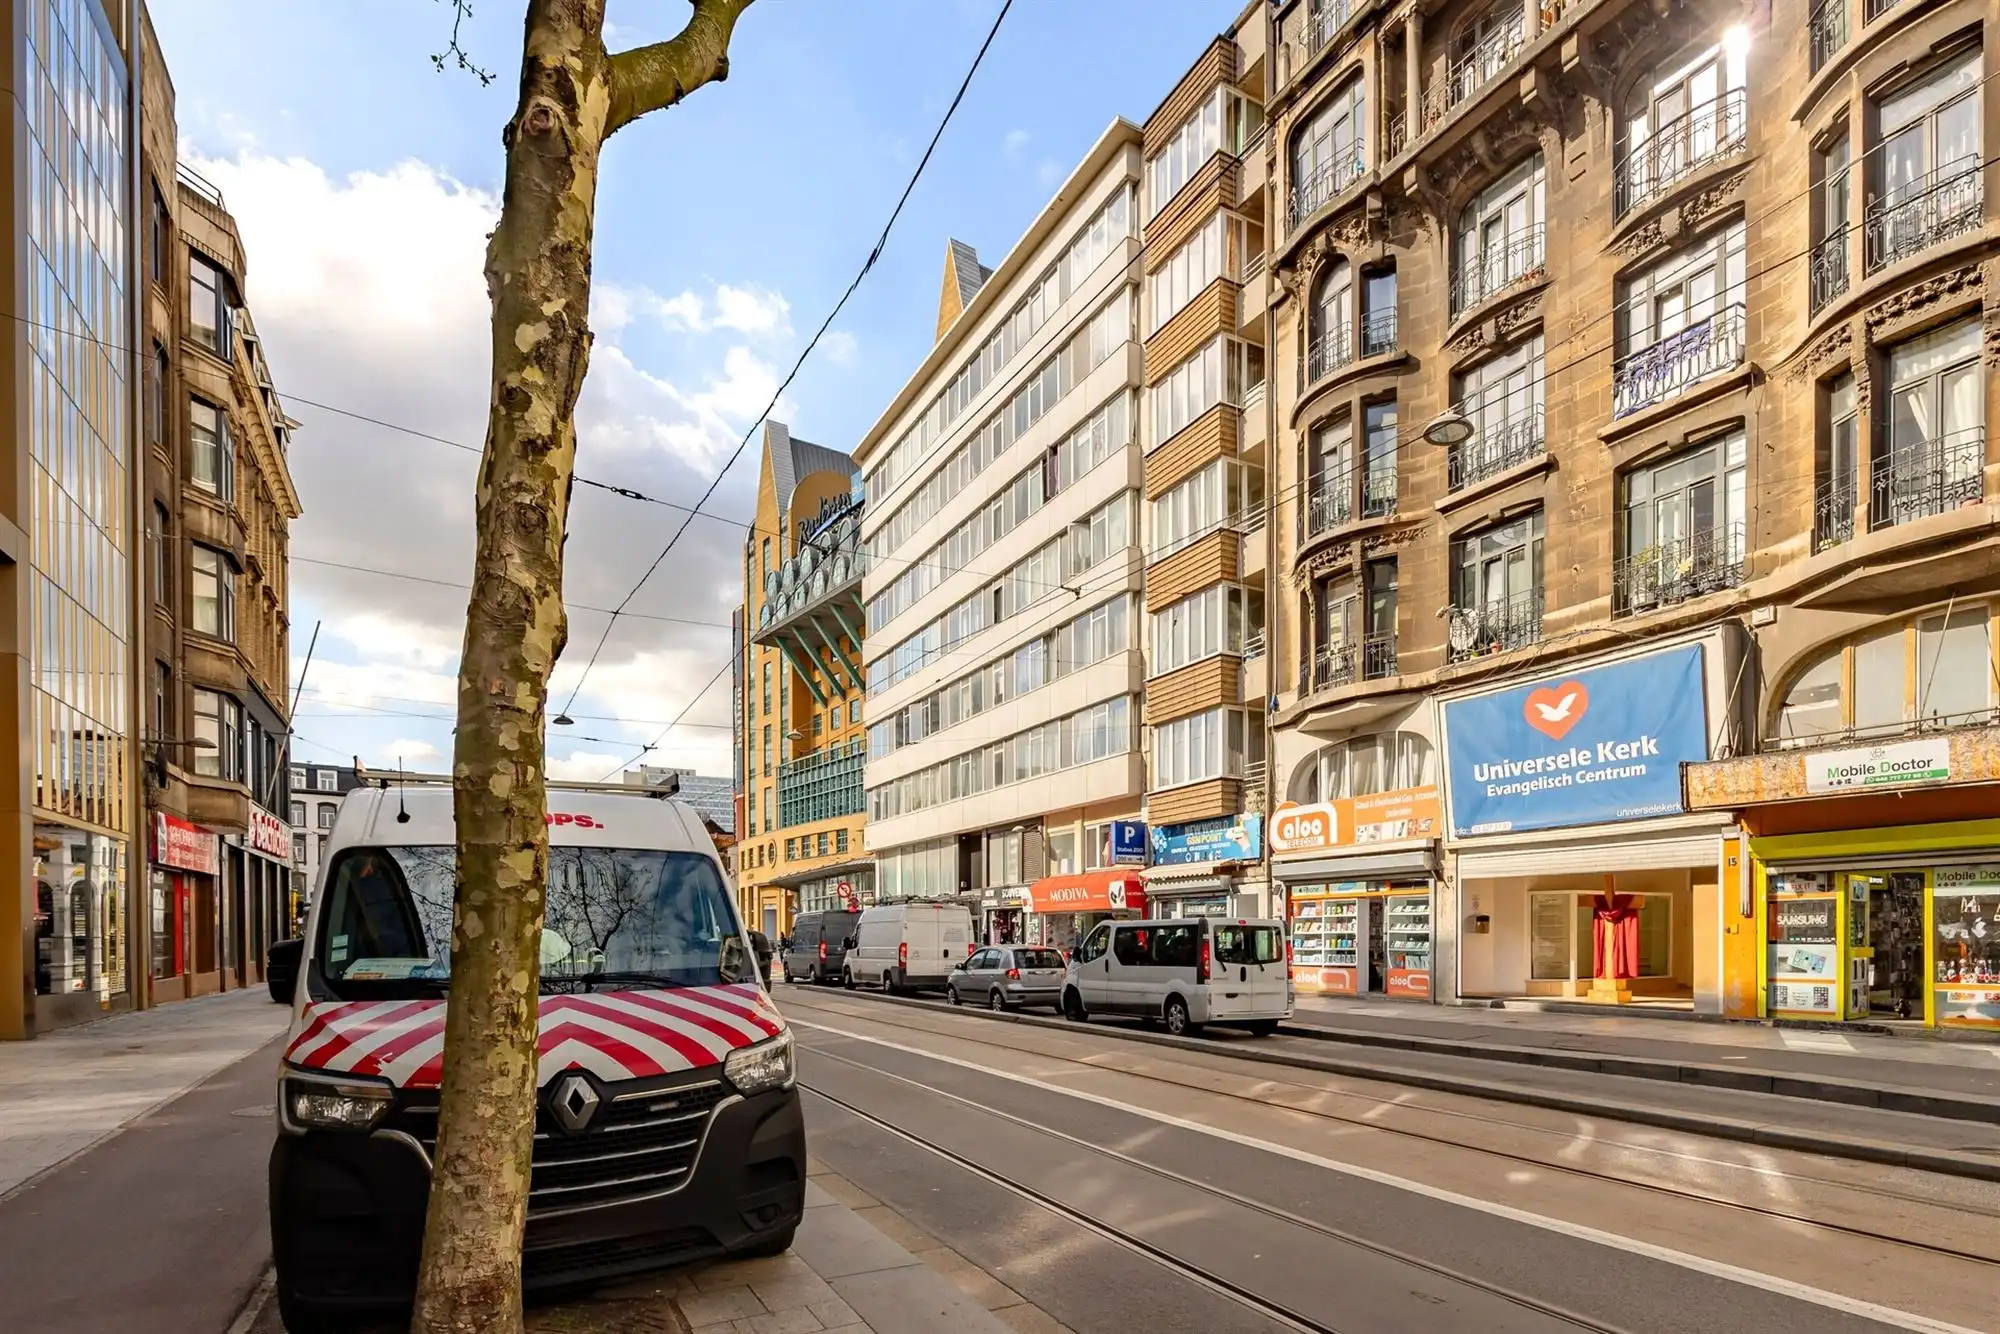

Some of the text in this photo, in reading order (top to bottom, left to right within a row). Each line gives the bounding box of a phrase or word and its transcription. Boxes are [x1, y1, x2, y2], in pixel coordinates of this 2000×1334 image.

[1474, 735, 1660, 783] Universele Kerk
[1827, 758, 1933, 779] Mobile Doctor
[1486, 763, 1647, 797] Evangelisch Centrum
[1124, 826, 1136, 844] P
[1283, 816, 1322, 839] aloo
[1728, 857, 1737, 867] 15
[1937, 871, 1976, 882] Mobile
[1049, 887, 1089, 902] MODIVA
[1776, 914, 1827, 926] SAMSUNG
[1295, 971, 1318, 985] aloo
[1389, 975, 1408, 986] aloo
